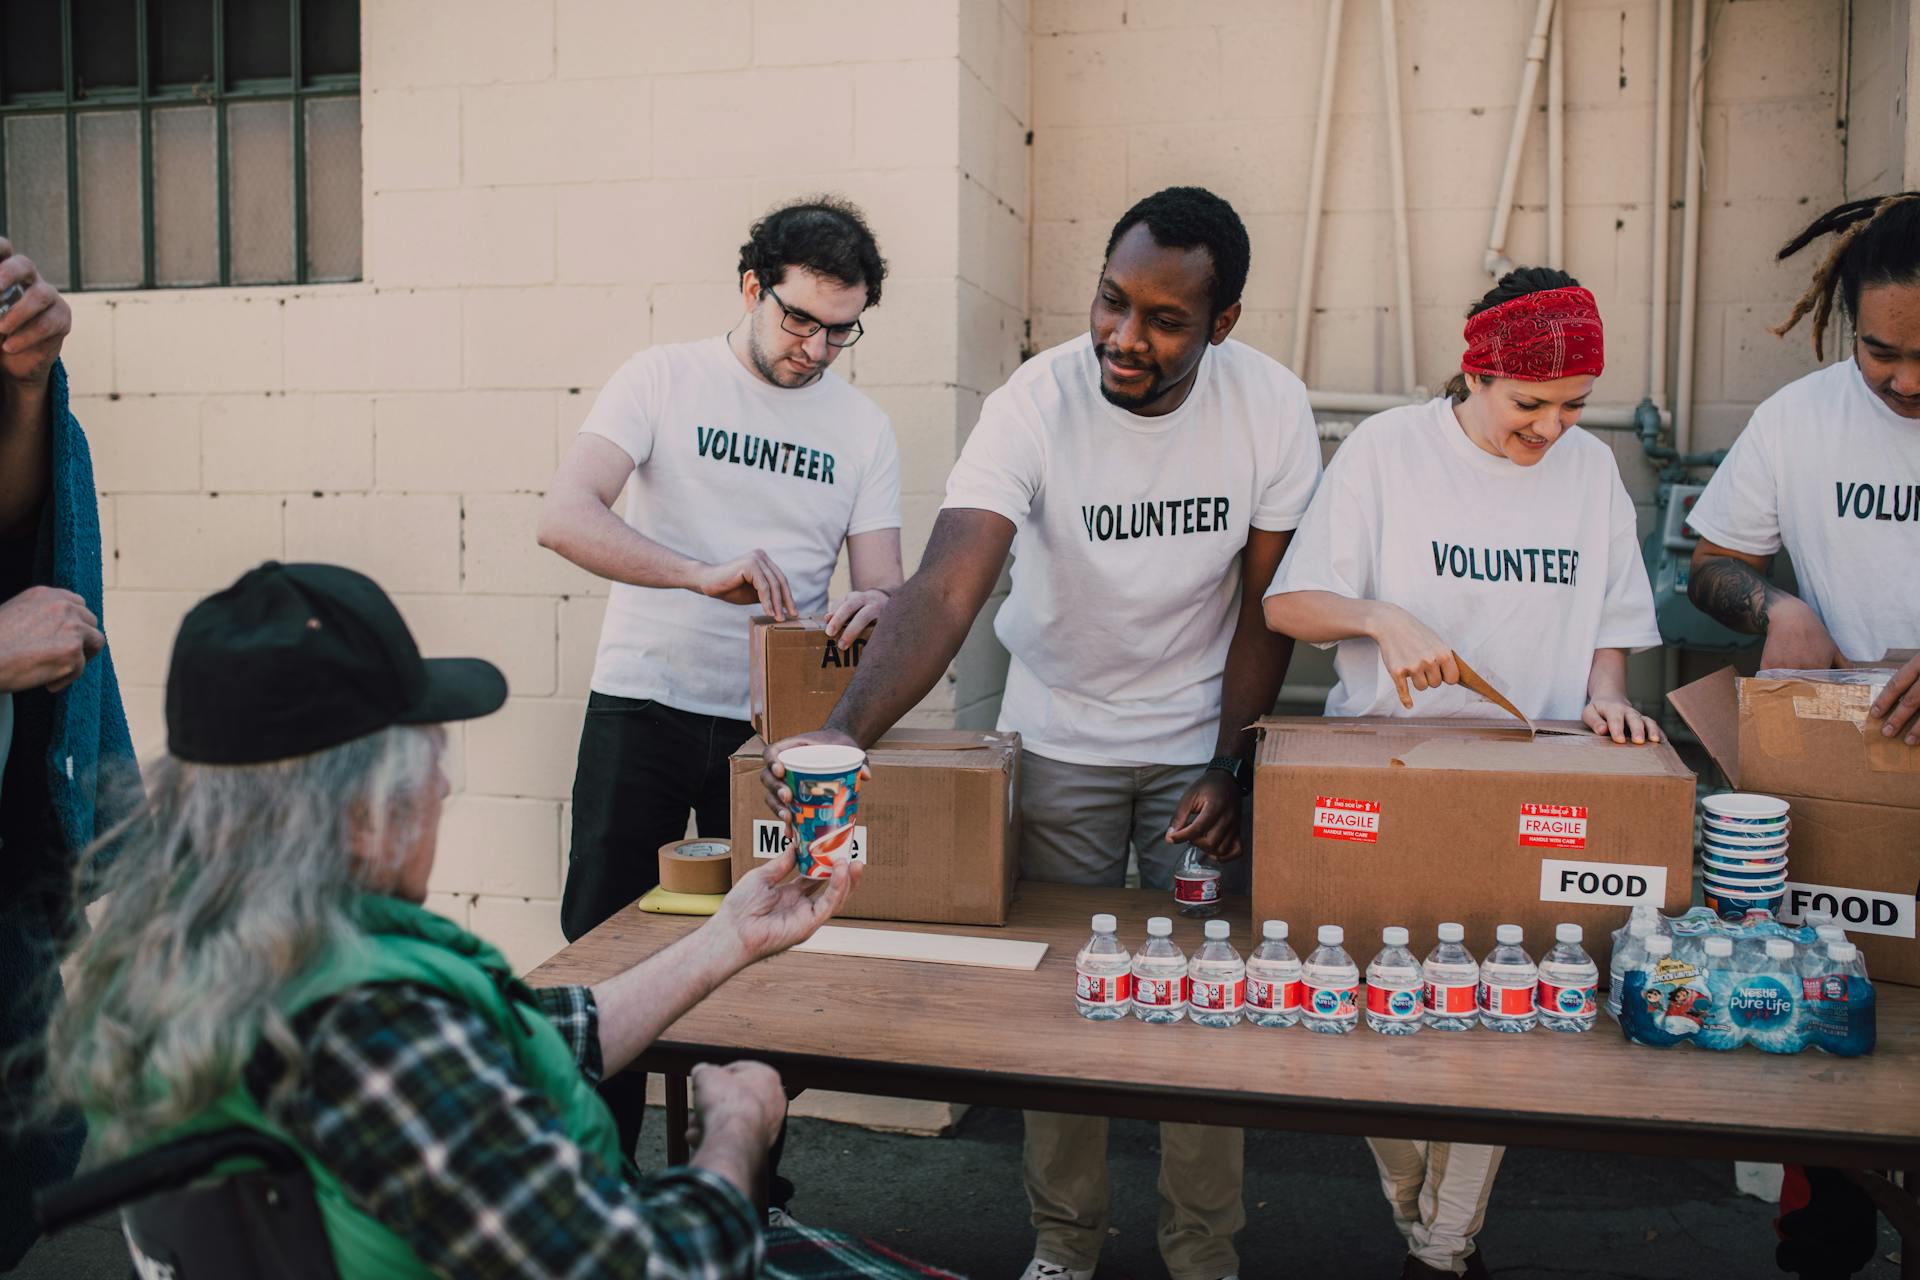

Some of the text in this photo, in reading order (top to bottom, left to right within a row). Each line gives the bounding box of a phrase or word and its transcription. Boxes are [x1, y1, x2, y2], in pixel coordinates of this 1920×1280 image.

[697, 426, 834, 484] VOLUNTEER
[1082, 497, 1229, 542] VOLUNTEER
[1432, 541, 1579, 587] VOLUNTEER
[1321, 812, 1374, 828] FRAGILE
[1526, 820, 1581, 834] FRAGILE
[1560, 870, 1647, 897] FOOD
[1791, 890, 1899, 926] FOOD
[1730, 997, 1764, 1009] Pure
[1766, 998, 1791, 1016] Life
